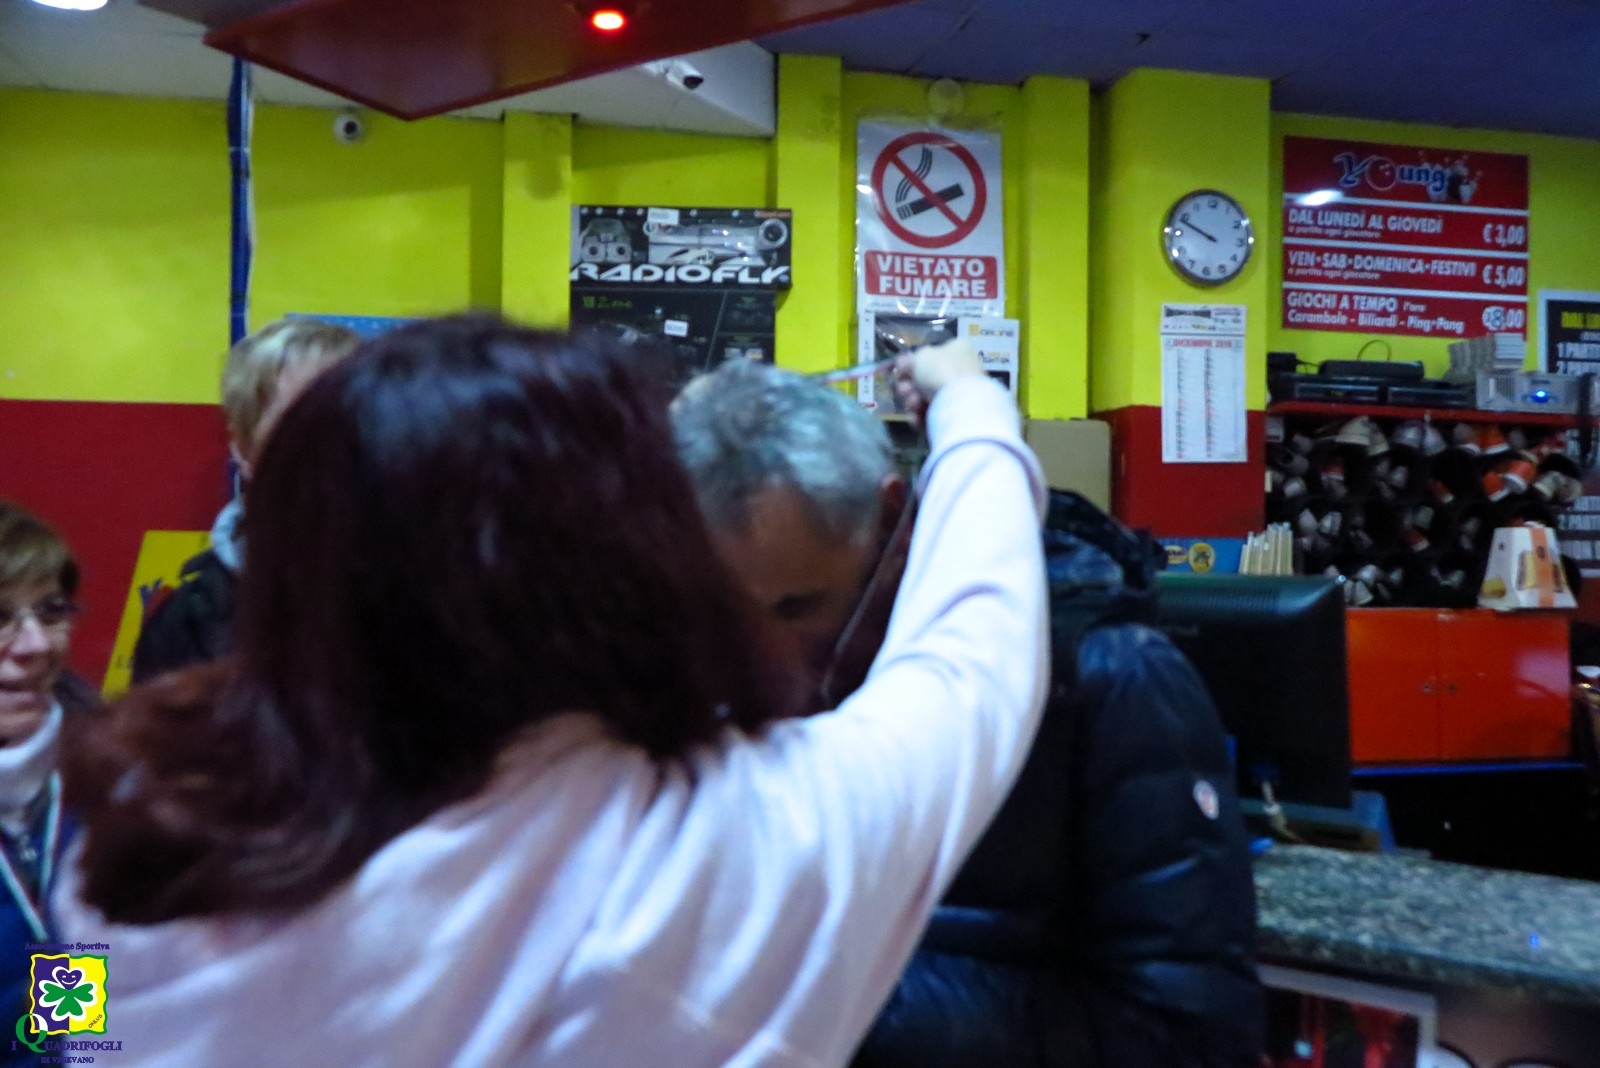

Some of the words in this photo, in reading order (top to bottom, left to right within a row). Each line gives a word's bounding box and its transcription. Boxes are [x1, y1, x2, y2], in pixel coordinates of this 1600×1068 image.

[1288, 208, 1314, 224] DAL
[1367, 214, 1384, 229] AL
[569, 262, 790, 284] RADIOFLY
[876, 253, 985, 277] VIETATO
[879, 275, 987, 298] FUMARE
[1287, 291, 1338, 309] GIOCHI
[1339, 294, 1351, 310] A
[1352, 294, 1398, 312] TEMPO
